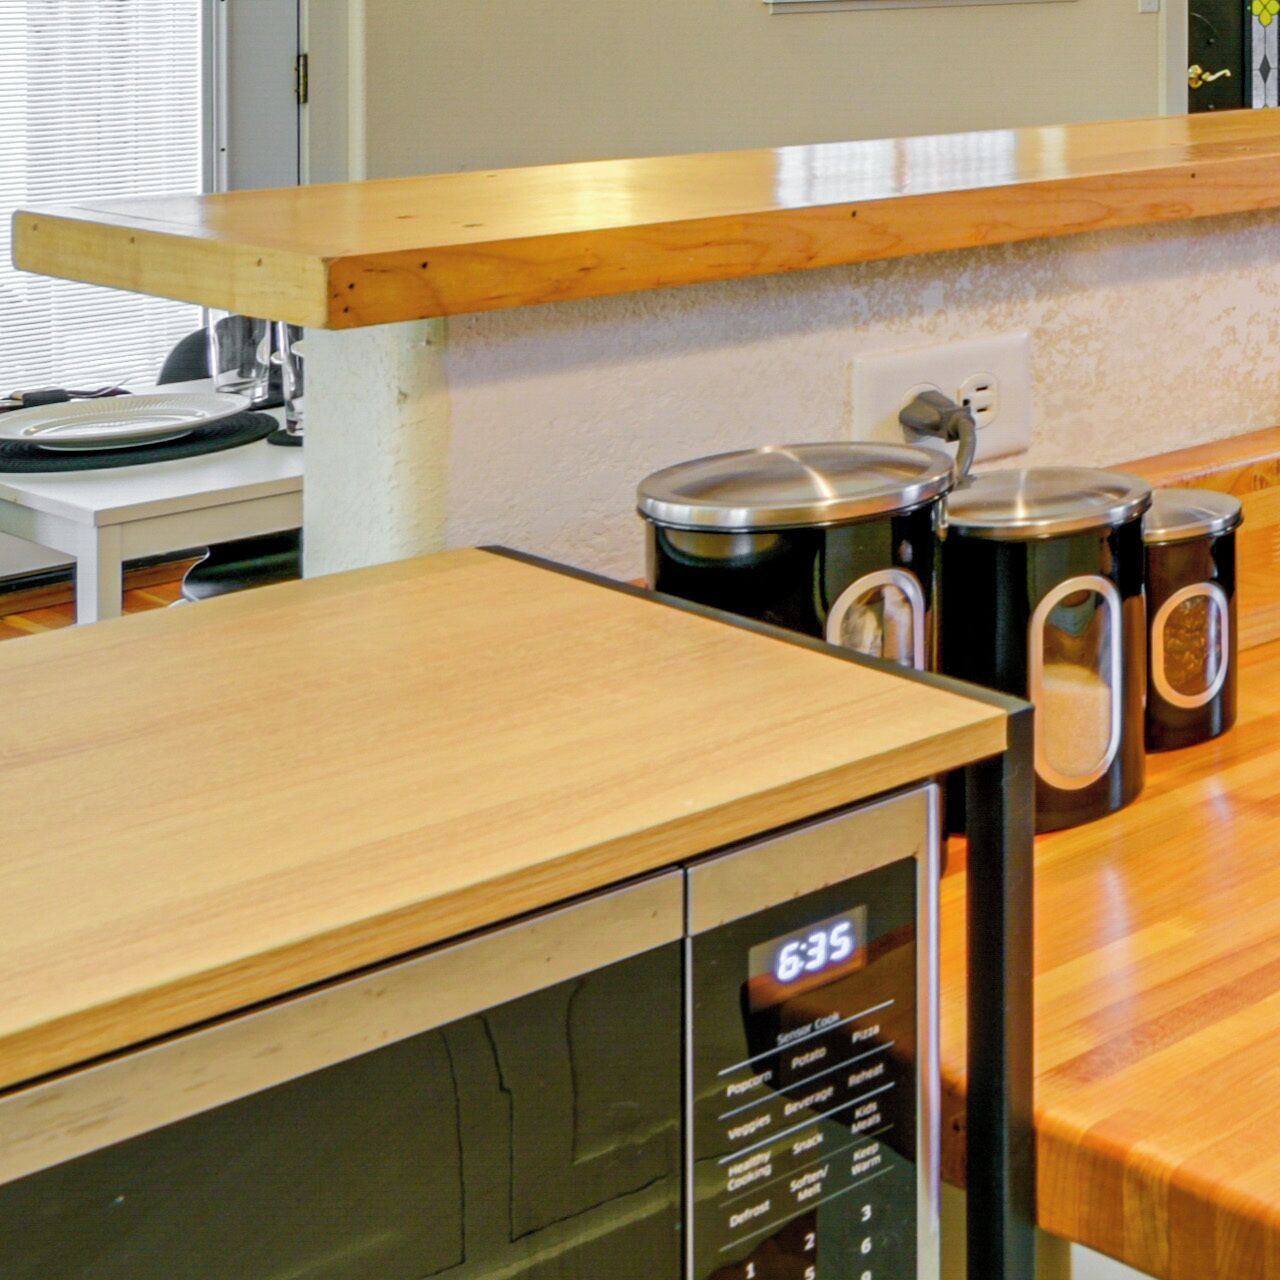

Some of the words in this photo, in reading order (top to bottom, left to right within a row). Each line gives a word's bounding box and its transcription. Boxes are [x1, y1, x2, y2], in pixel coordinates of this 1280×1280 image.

[776, 921, 853, 982] 6:35
[777, 1022, 812, 1046] Sensor
[814, 1012, 841, 1030] Cook
[852, 1024, 881, 1044] Pizza
[791, 1046, 827, 1070] Potato
[726, 1070, 773, 1098] Popcorn
[848, 1062, 884, 1088] Reheat
[784, 1086, 834, 1117] Beverage
[855, 1101, 878, 1119] Kids
[728, 1114, 771, 1141] Veggies
[851, 1112, 881, 1134] Meals
[792, 1132, 824, 1156] Snack
[853, 1142, 880, 1162] Keep
[728, 1150, 771, 1178] Healthy
[851, 1154, 882, 1176] Warm
[728, 1164, 773, 1192] Cooking
[790, 1164, 829, 1194] Soften/
[797, 1182, 822, 1203] Melt
[729, 1199, 771, 1229] Defrost
[861, 1204, 873, 1222] 3
[804, 1232, 816, 1252] 2
[860, 1236, 873, 1255] 6
[746, 1261, 756, 1280] 1
[804, 1266, 816, 1280] 5
